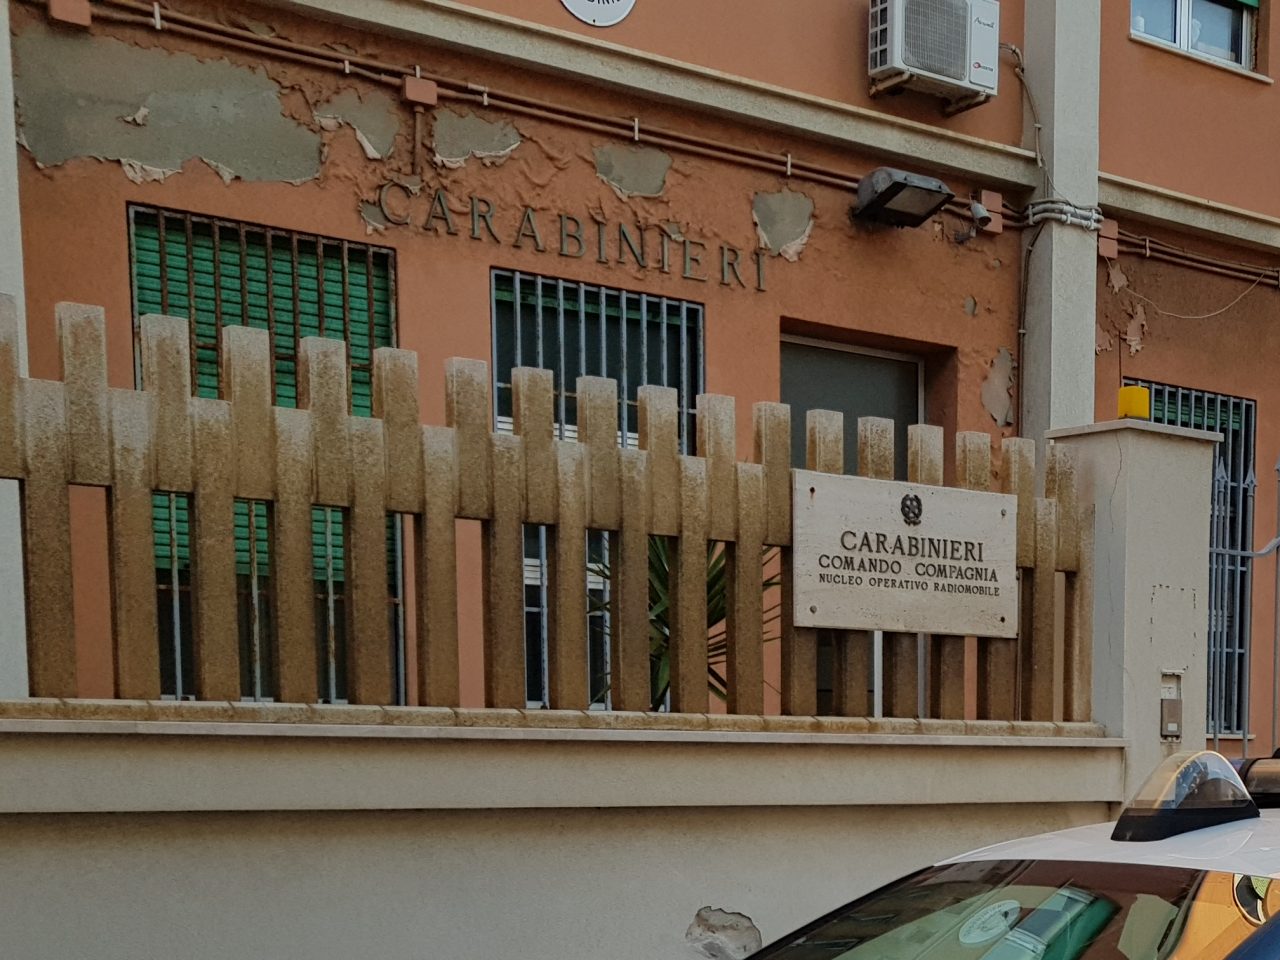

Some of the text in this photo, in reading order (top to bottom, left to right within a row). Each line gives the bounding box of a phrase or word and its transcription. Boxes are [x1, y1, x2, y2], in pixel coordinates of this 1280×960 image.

[379, 181, 767, 292] CARABINIERI
[840, 530, 984, 562] CARABINIERI
[818, 554, 998, 583] COMANDO COMPAGNIA
[819, 573, 1000, 597] NUCLEO OPERATIVO RADIOMOBILE
